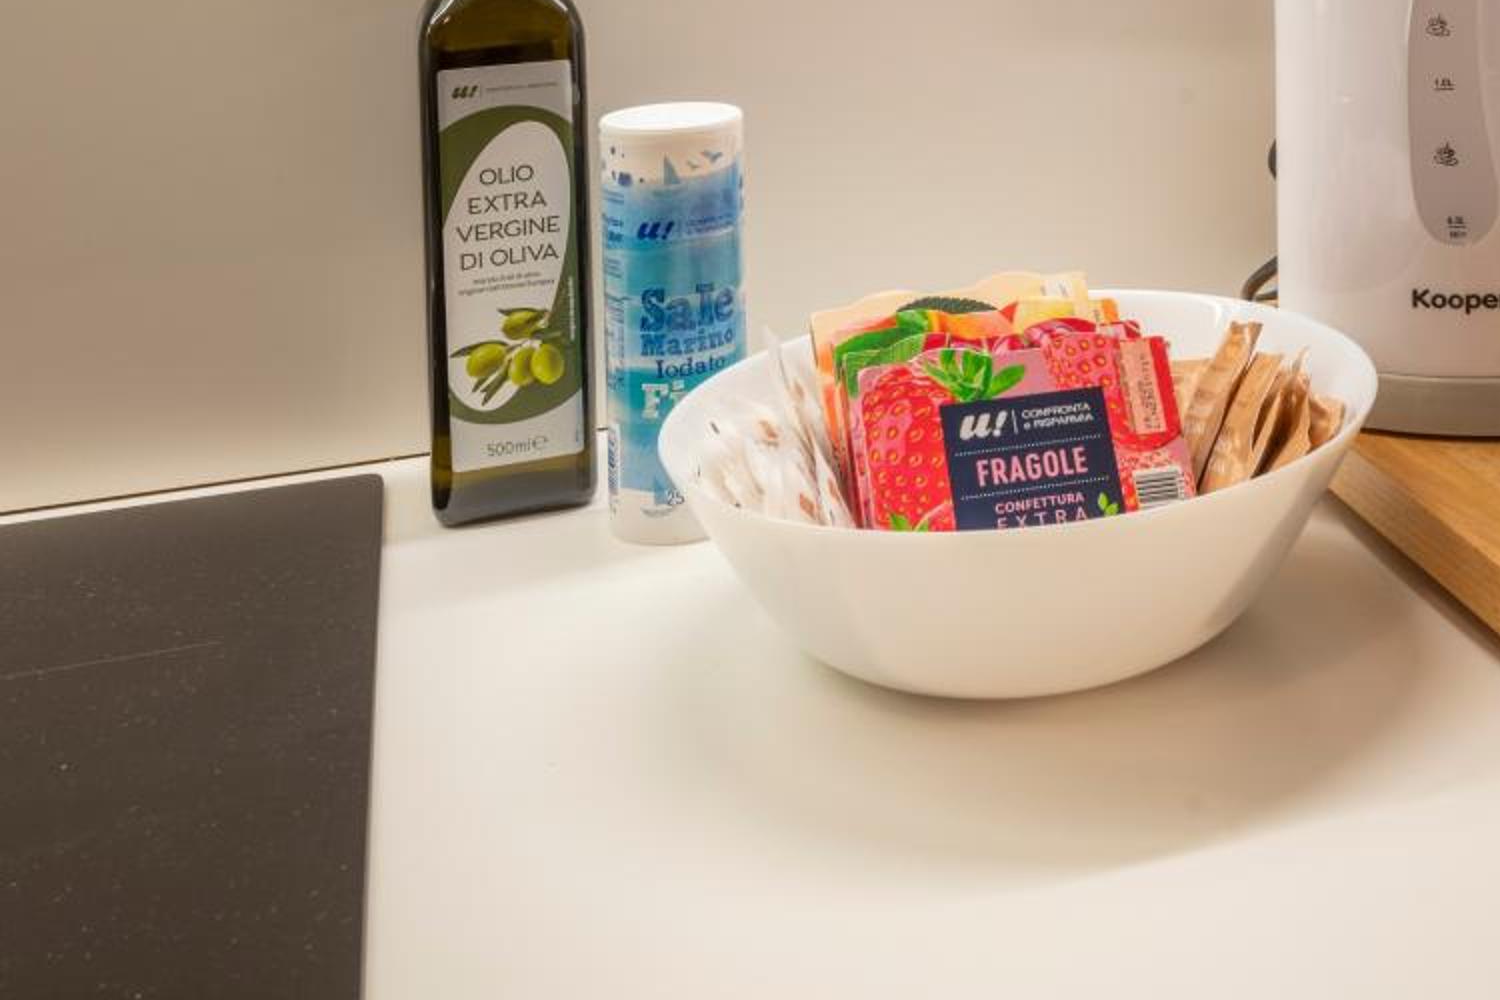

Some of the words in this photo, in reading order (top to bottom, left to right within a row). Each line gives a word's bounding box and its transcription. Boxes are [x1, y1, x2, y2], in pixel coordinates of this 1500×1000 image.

[479, 164, 534, 185] OLIO
[468, 190, 548, 215] EXTRA
[455, 215, 561, 243] VERGINE
[460, 252, 484, 271] DI
[489, 243, 559, 267] OLIVA
[640, 284, 734, 332] Sale
[640, 326, 733, 357] Marino
[655, 355, 726, 380] Iodato
[1021, 402, 1091, 421] CONFRONTA
[1033, 413, 1094, 430] RISPARMIA
[975, 446, 1089, 487] FRAGOLE
[994, 491, 1085, 515] CONFETTURA
